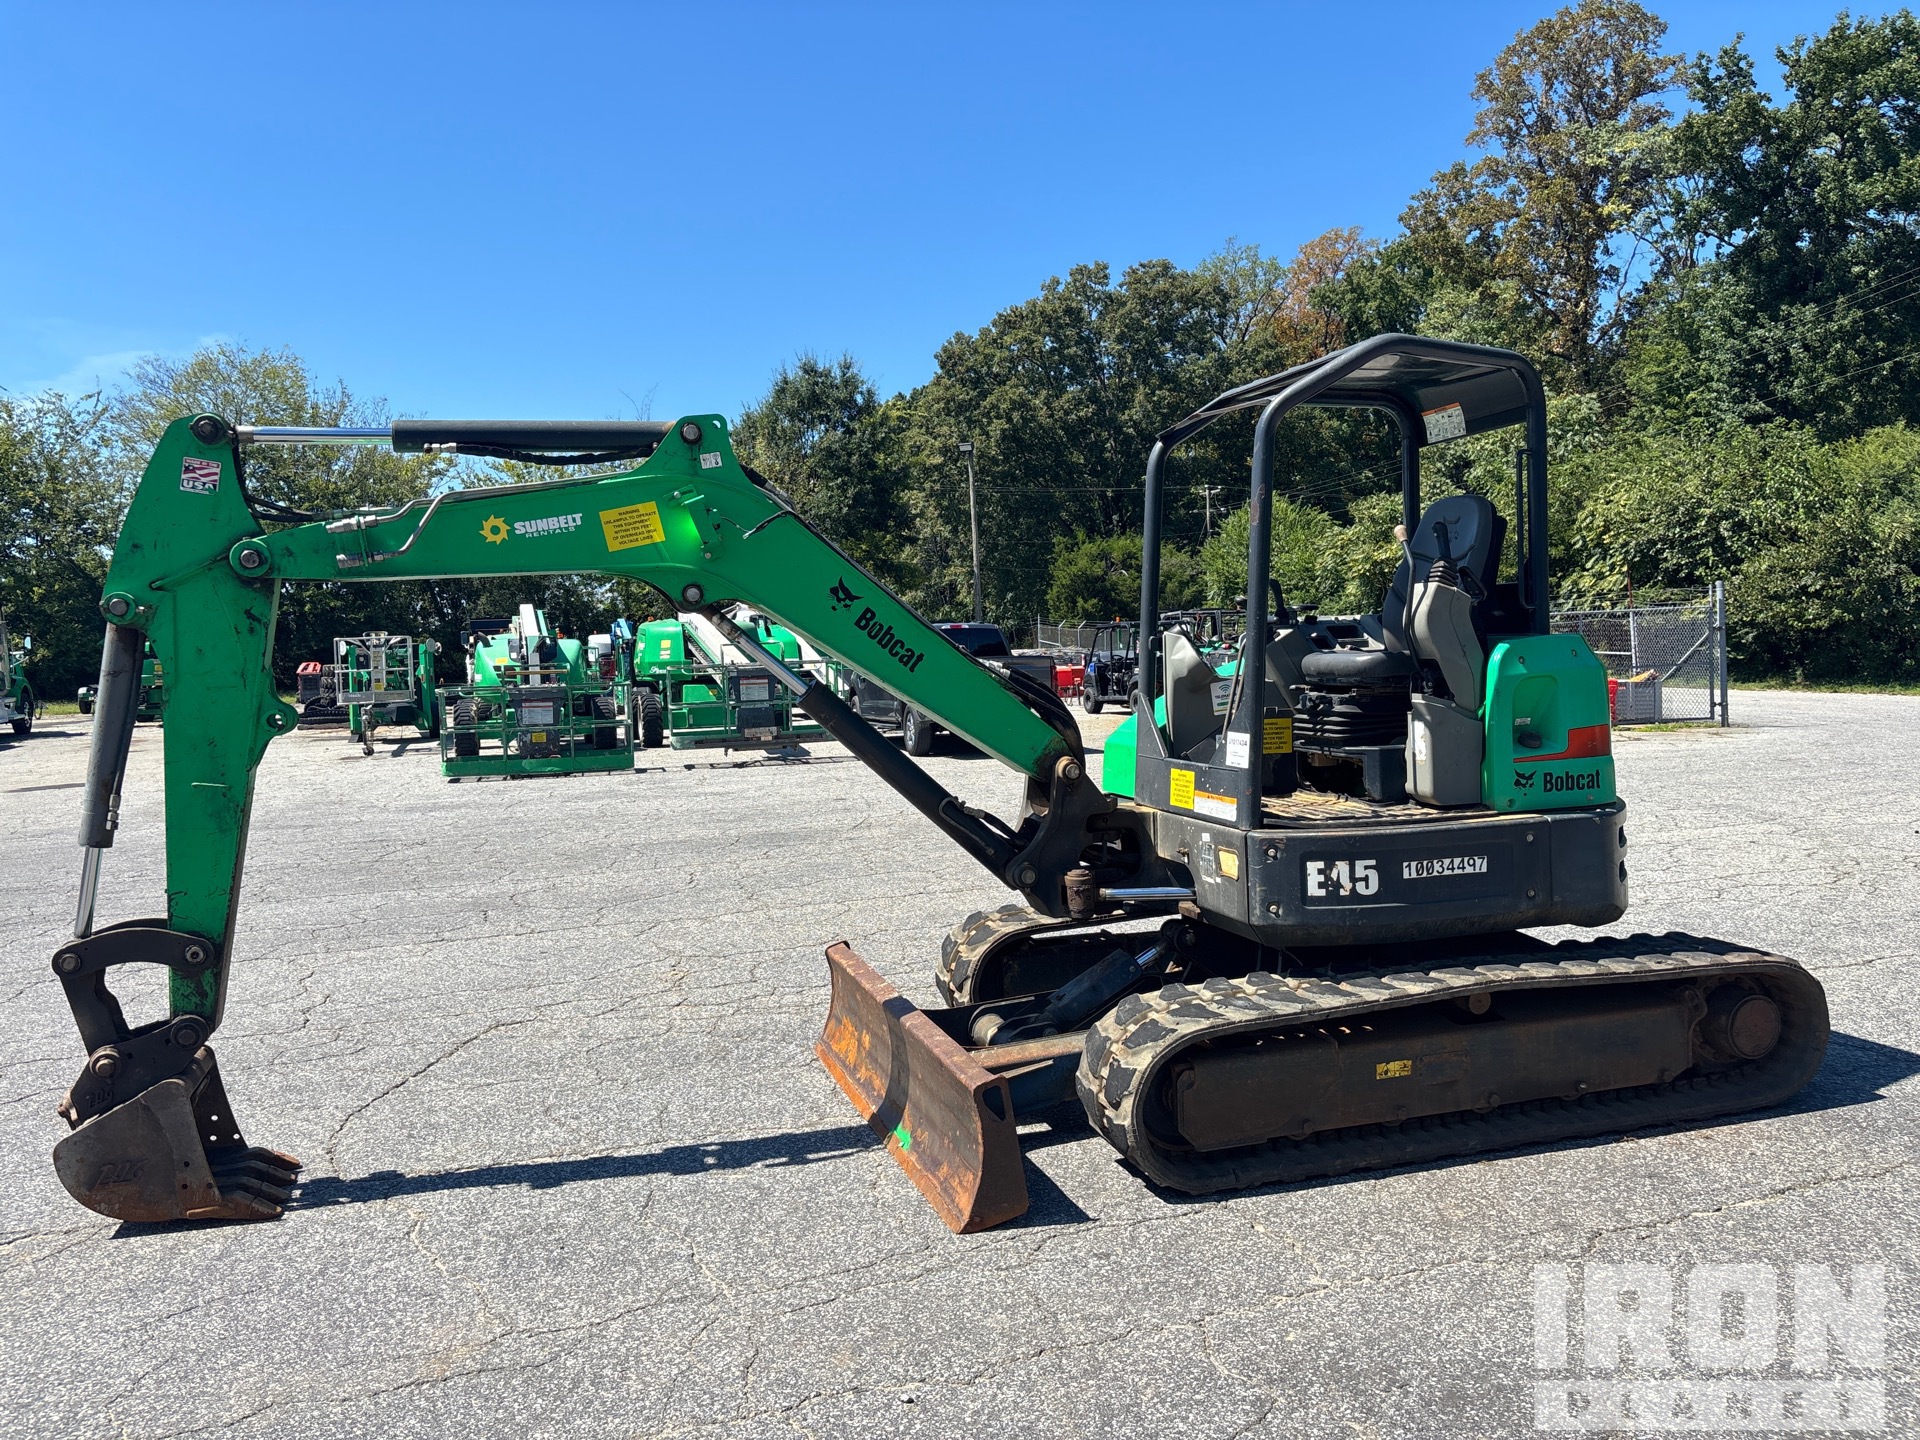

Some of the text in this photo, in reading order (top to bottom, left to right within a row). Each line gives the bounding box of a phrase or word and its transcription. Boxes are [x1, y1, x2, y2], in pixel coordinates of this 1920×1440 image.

[183, 480, 215, 490] USA
[603, 517, 629, 525] UNLAWFUL
[636, 511, 657, 519] OPERATE
[618, 508, 640, 516] WARNING
[514, 513, 583, 535] SUNBELT
[624, 518, 651, 526] EQUIPMENT
[525, 526, 576, 538] RENTALS
[620, 531, 645, 540] OVERHEAD
[854, 606, 925, 673] Bobcat
[1543, 769, 1601, 793] Bobcat
[1306, 856, 1486, 897] E45 10034497
